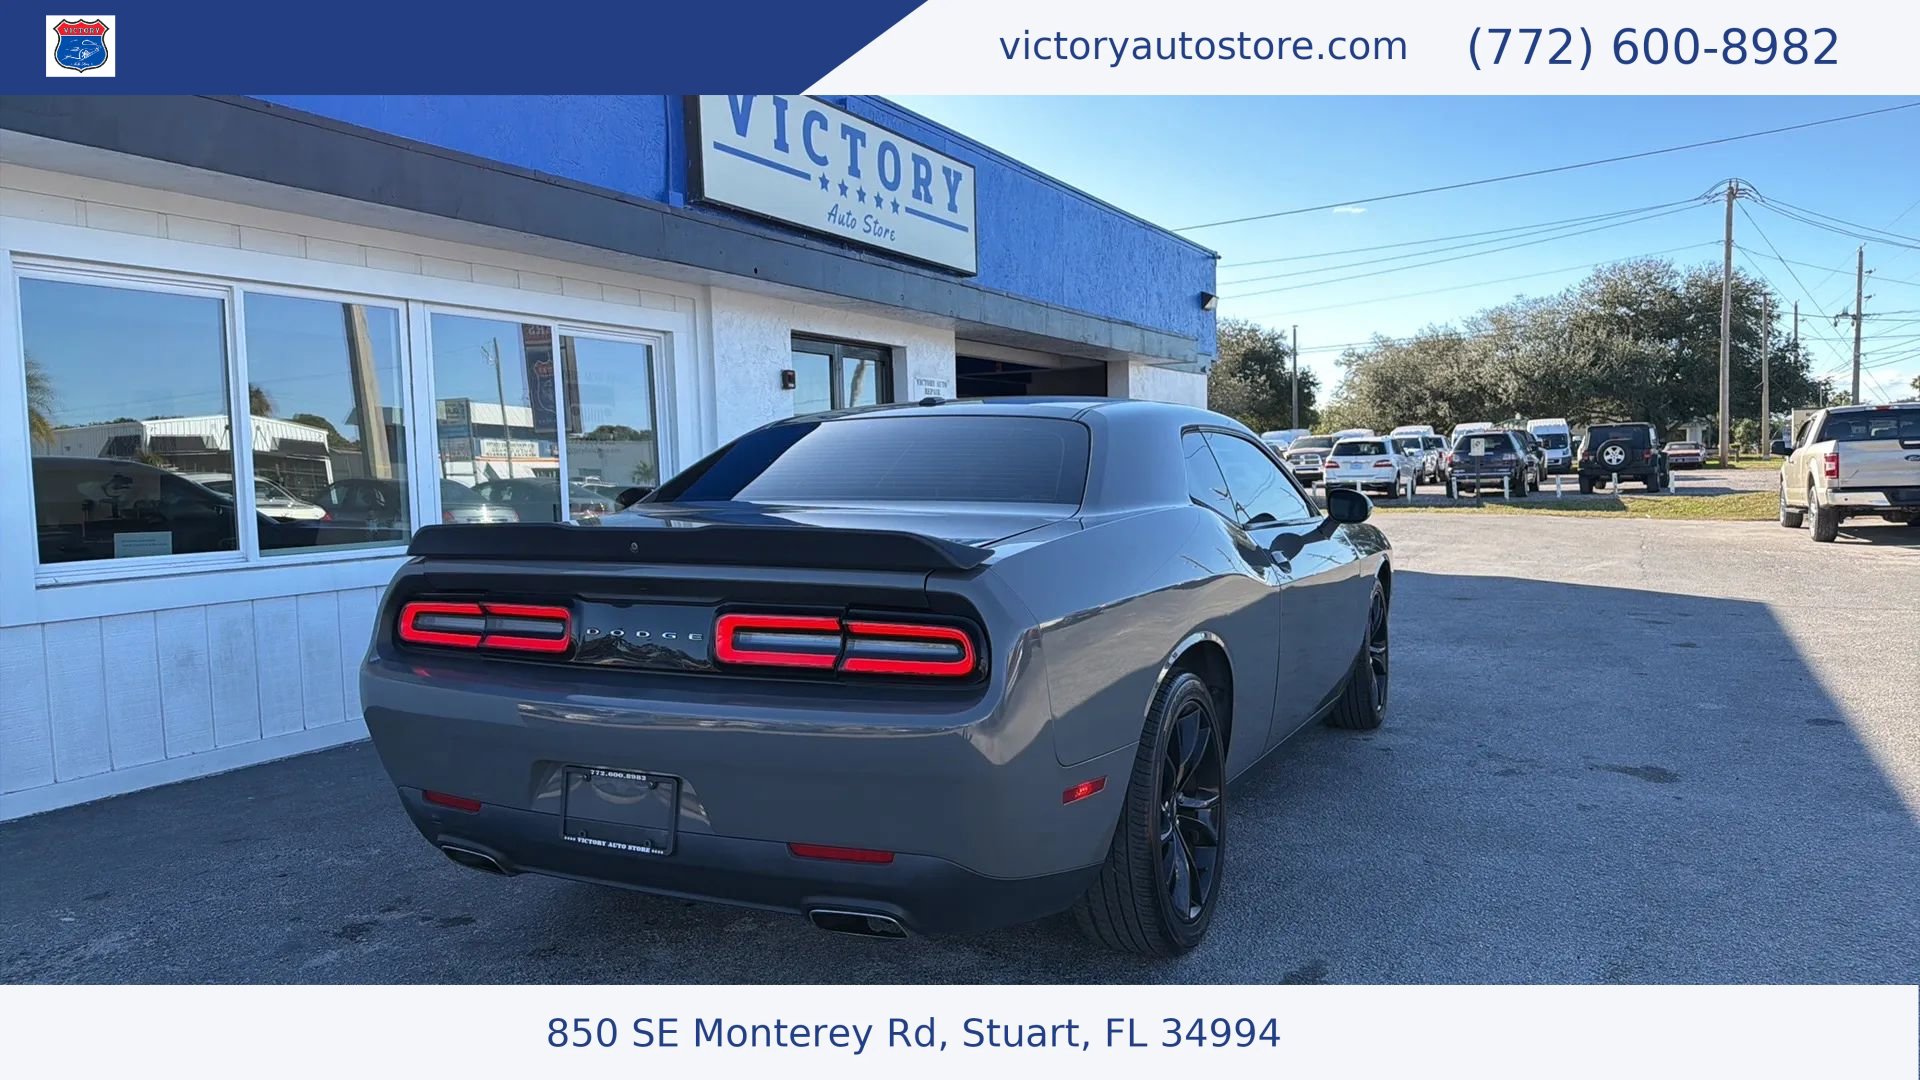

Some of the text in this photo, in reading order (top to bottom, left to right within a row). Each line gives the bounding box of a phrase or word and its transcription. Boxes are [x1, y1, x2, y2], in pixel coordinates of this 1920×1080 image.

[727, 95, 963, 214] VICTORY
[827, 203, 896, 242] Auto Store
[586, 627, 703, 641] DODGE
[577, 837, 651, 854] VICTORY AUTO STORE
